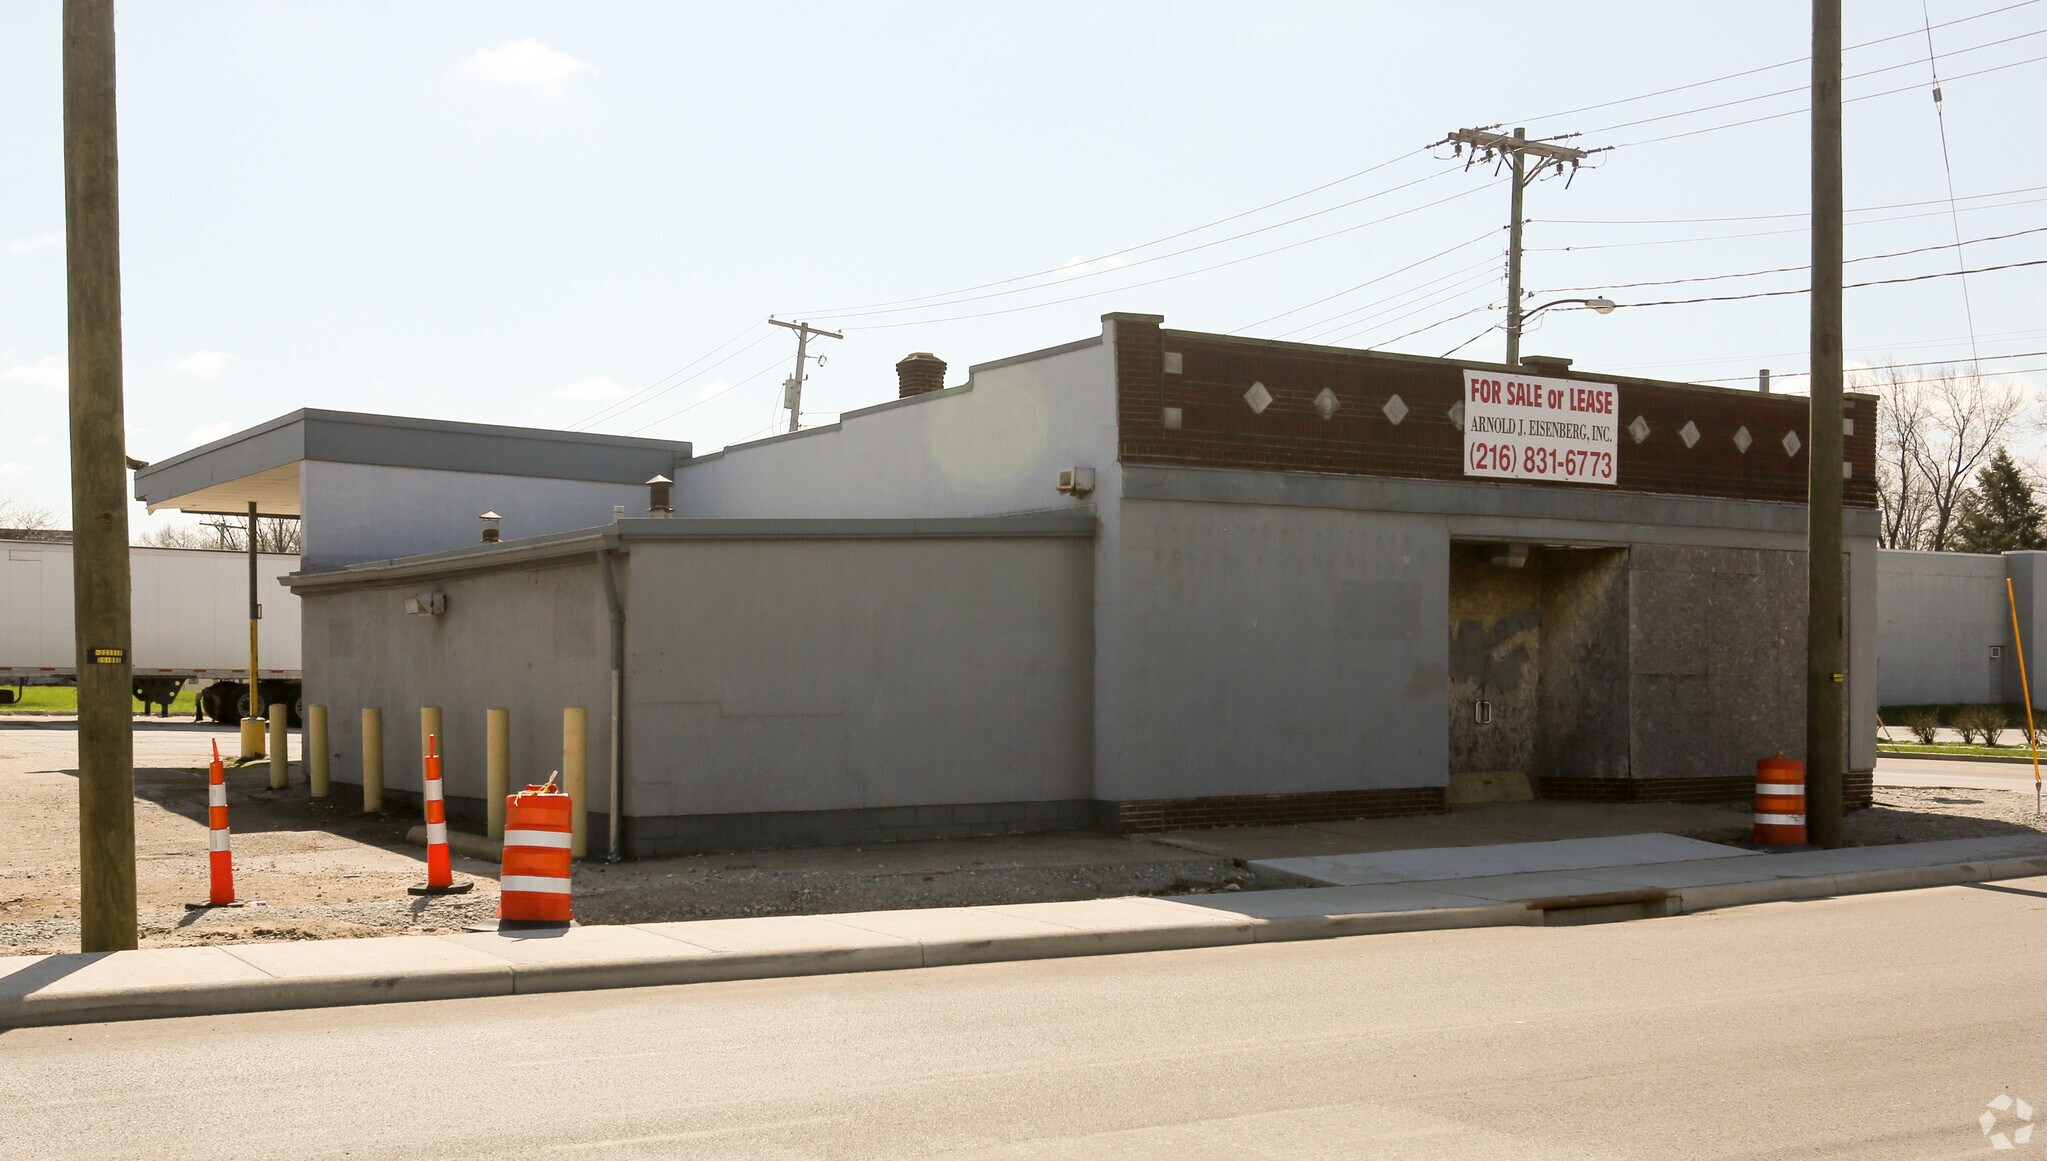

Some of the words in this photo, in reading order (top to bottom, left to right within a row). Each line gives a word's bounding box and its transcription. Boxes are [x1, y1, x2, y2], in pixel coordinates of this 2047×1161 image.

[1471, 378, 1501, 404] FOR
[1506, 381, 1542, 408] SALE
[1547, 388, 1564, 410] or
[1570, 388, 1613, 415] LEASE
[1470, 415, 1516, 434] ARNOLD
[1517, 418, 1527, 437] J.
[1529, 420, 1590, 443] EISENBERG,
[1592, 424, 1613, 442] INC.
[1470, 441, 1517, 473] (216)
[1523, 446, 1612, 479] 831-6773
